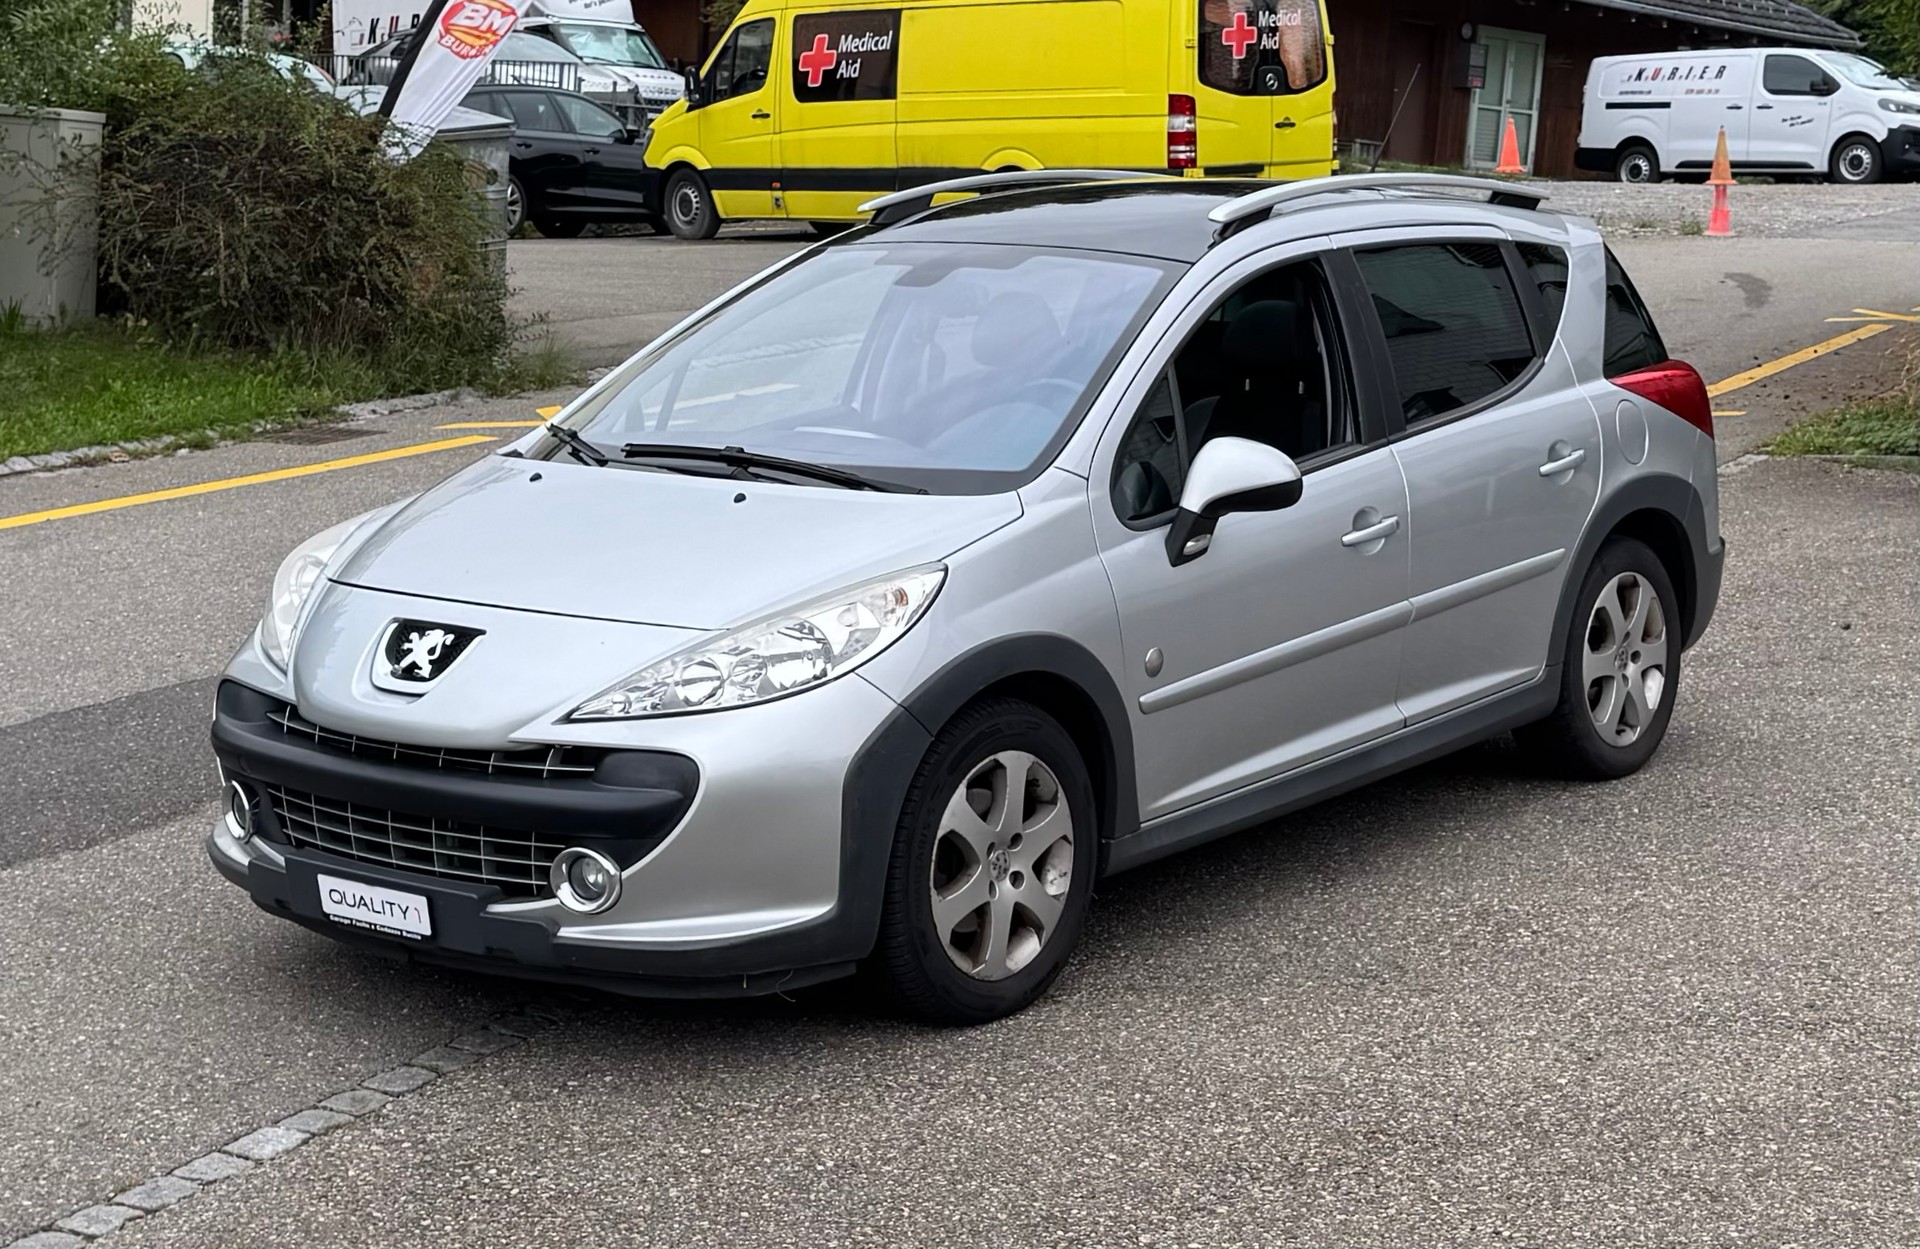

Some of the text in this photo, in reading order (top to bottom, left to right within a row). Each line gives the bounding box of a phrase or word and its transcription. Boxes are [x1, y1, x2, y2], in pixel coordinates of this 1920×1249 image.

[449, 2, 517, 36] BM
[1258, 9, 1301, 27] Medical
[838, 30, 893, 53] Medical
[1260, 33, 1279, 50] Aid
[836, 58, 861, 79] Aid
[1634, 65, 1727, 82] KURIER
[328, 889, 409, 920] QUALITY
